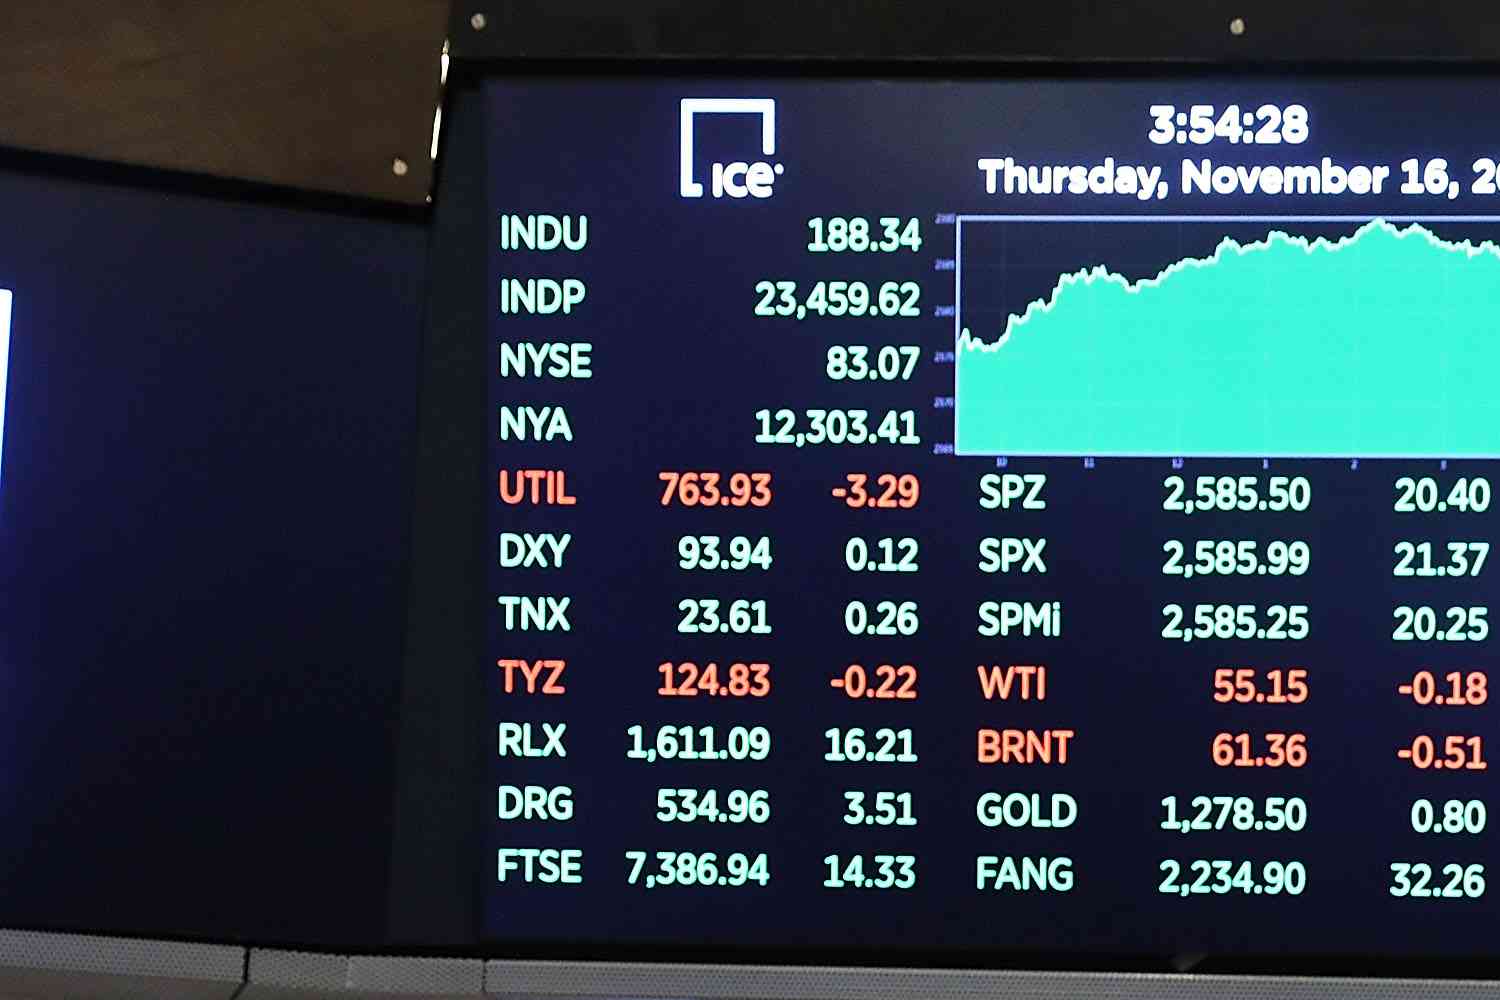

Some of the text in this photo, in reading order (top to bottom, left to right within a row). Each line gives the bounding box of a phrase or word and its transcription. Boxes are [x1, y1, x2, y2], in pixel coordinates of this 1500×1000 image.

[1148, 104, 1309, 145] 3:54:28
[978, 156, 1169, 201] Thursday,
[1182, 156, 1390, 195] November
[1401, 157, 1460, 200] 16,
[502, 215, 922, 252] INDU 188.34
[502, 279, 920, 320] INDP 23,459.62
[501, 343, 920, 380] NYSE 83.07
[501, 407, 920, 447] NYA 12,303.41
[500, 470, 919, 507] UTIL 763.93 -3.29
[979, 474, 1490, 514] SPZ 2,585.50 20.40
[500, 533, 918, 571] DXY 93.94 0.12
[979, 538, 1489, 578] SPX 2,585.99 21.37
[499, 596, 918, 635] TNX 23.61 0.26
[978, 602, 1488, 642] SPMi 2,585.25 20.25
[498, 660, 916, 698] TYZ 124.83 -0.22
[978, 666, 1487, 705] WTI 55.15 -0.18
[499, 723, 917, 762] RLX 1,611.09 16.21
[978, 729, 1487, 769] BRNT 61.36 -0.51
[499, 786, 917, 825] DRG 534.96 3.51
[977, 793, 1486, 833] GOLD 1,278.50 0.80
[498, 849, 915, 888] FTSE 7,386.94 14.33
[977, 856, 1485, 897] FANG 2,234.90 32.26
